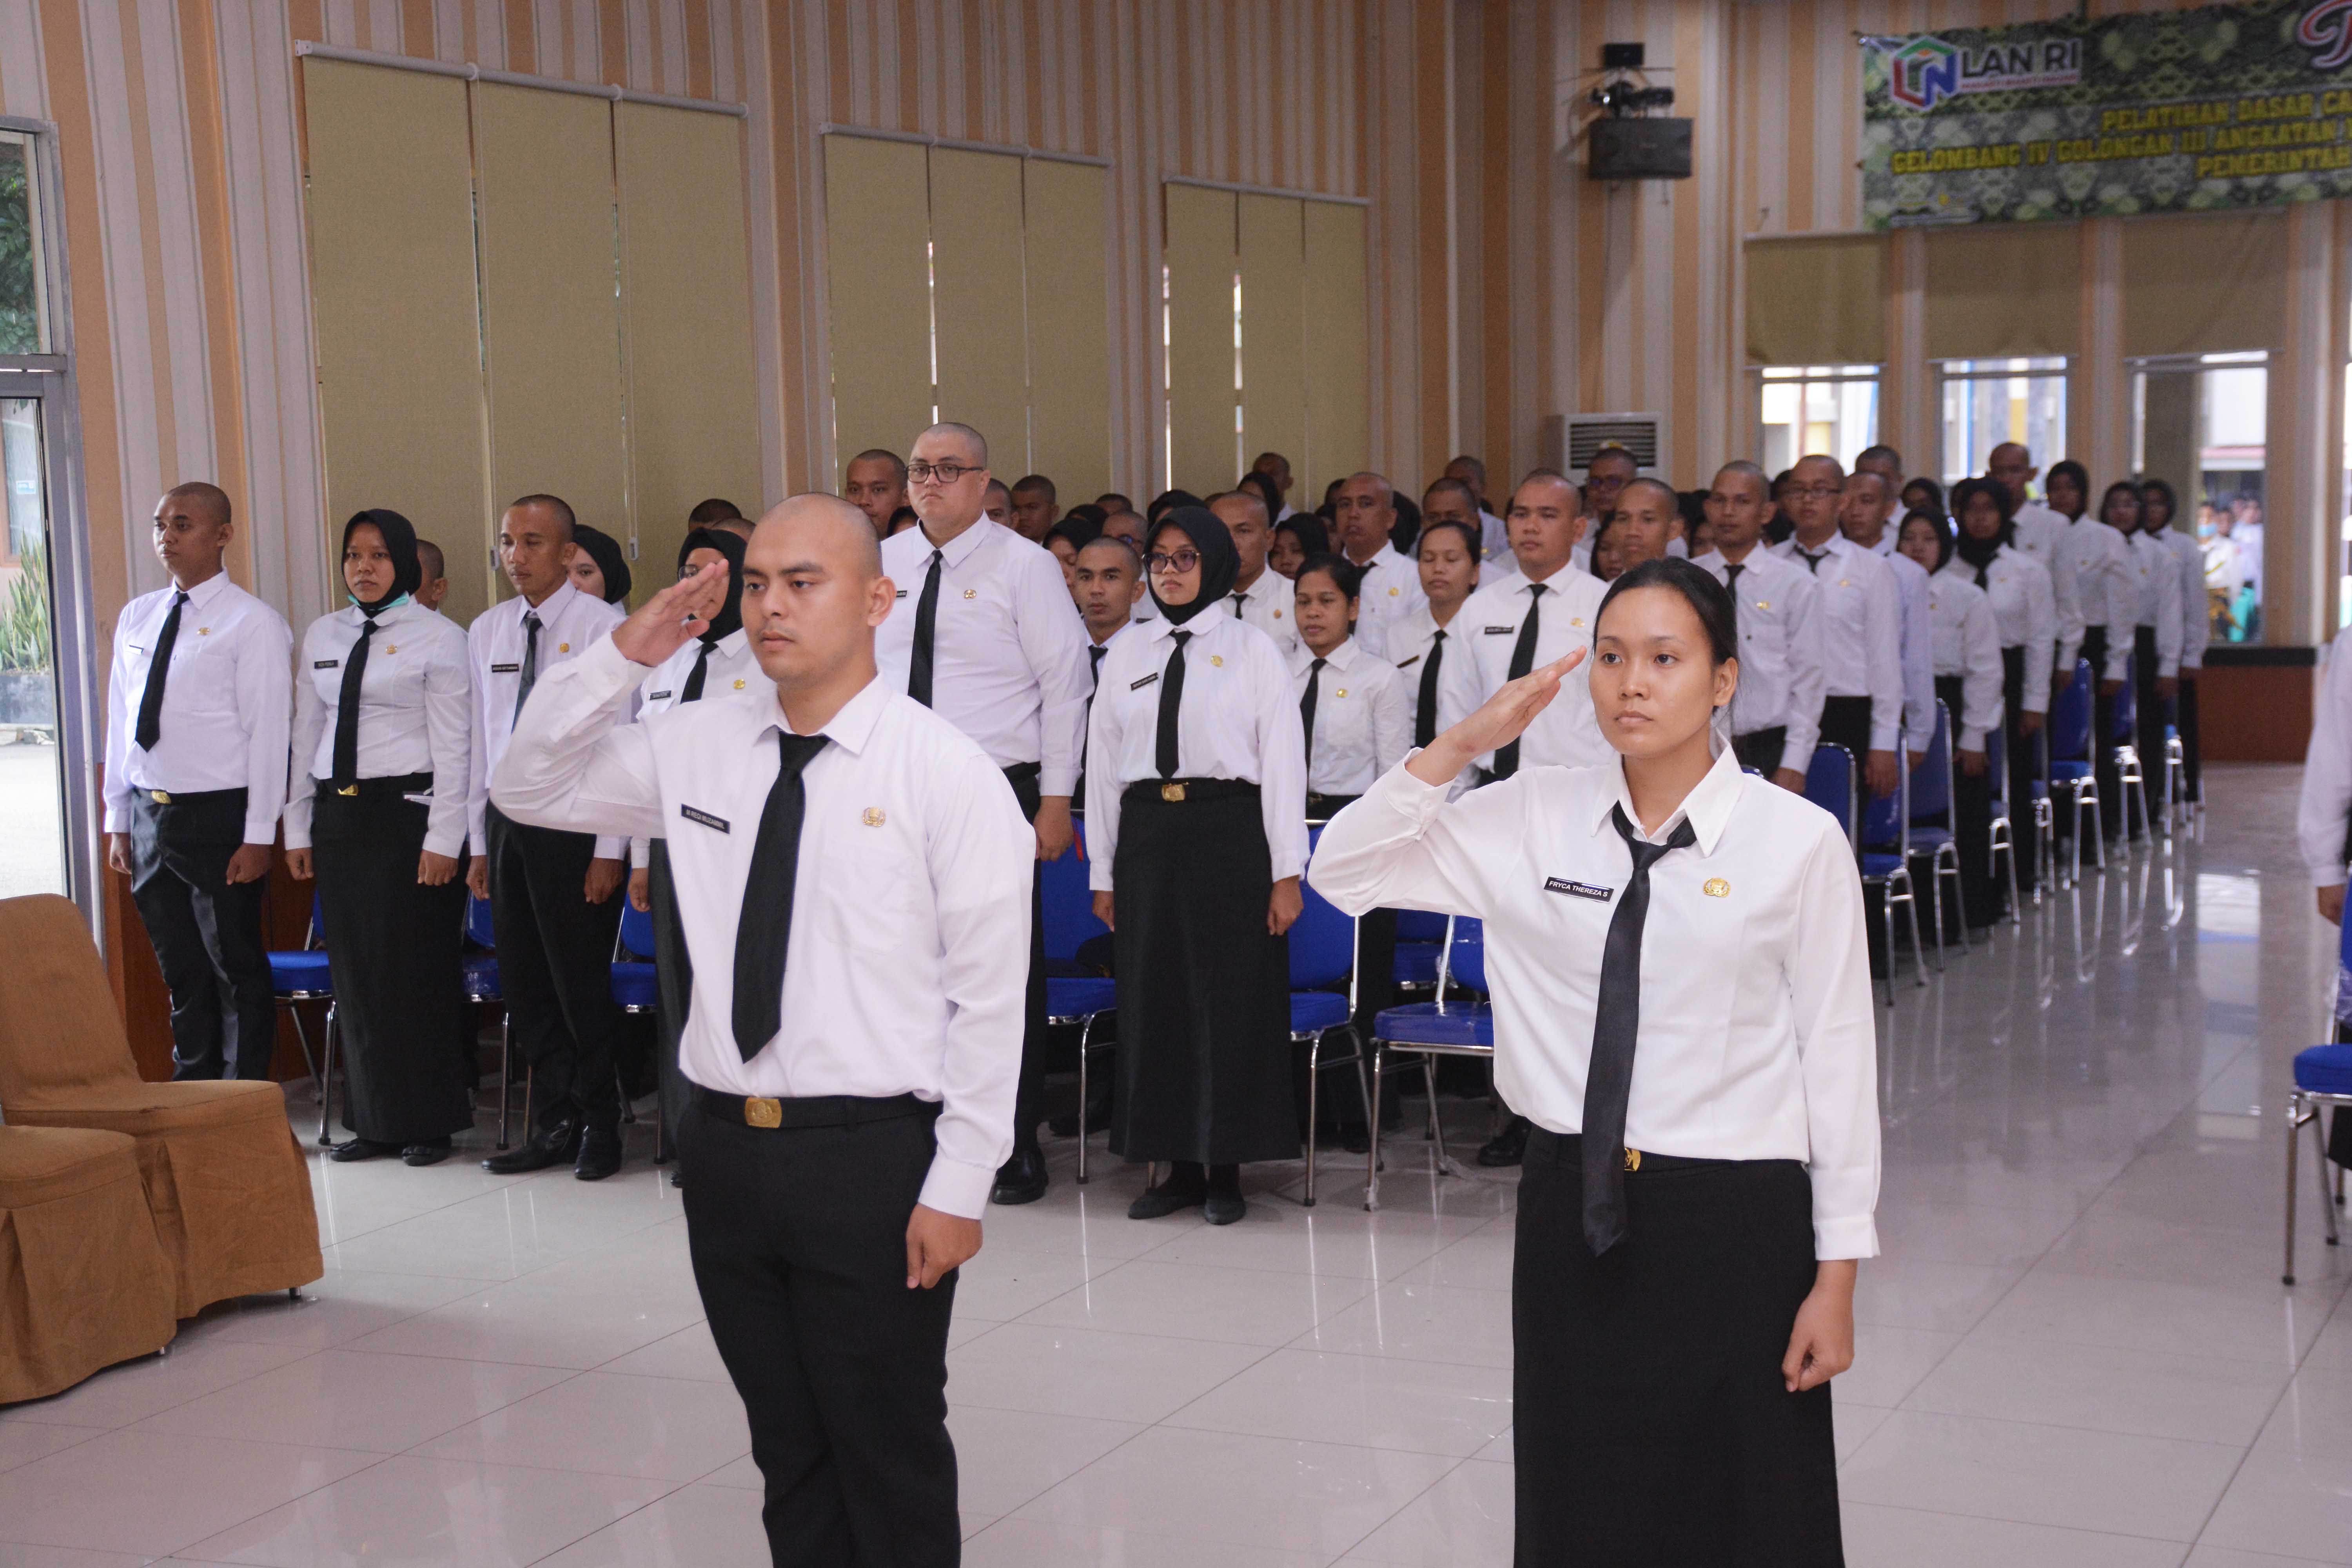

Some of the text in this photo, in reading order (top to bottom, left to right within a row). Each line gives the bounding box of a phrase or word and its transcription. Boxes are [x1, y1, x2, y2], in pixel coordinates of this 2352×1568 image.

[1962, 41, 2077, 78] LAN RI
[2102, 102, 2230, 132] PELATIHAN
[2238, 93, 2313, 121] DASAR
[1892, 142, 2021, 174] GELOMBANG
[2056, 133, 2174, 162] GOLONGAN
[2214, 119, 2337, 151] ANGKATAN
[1549, 880, 1571, 890] FRYCA
[1572, 885, 1602, 896] THEREZA
